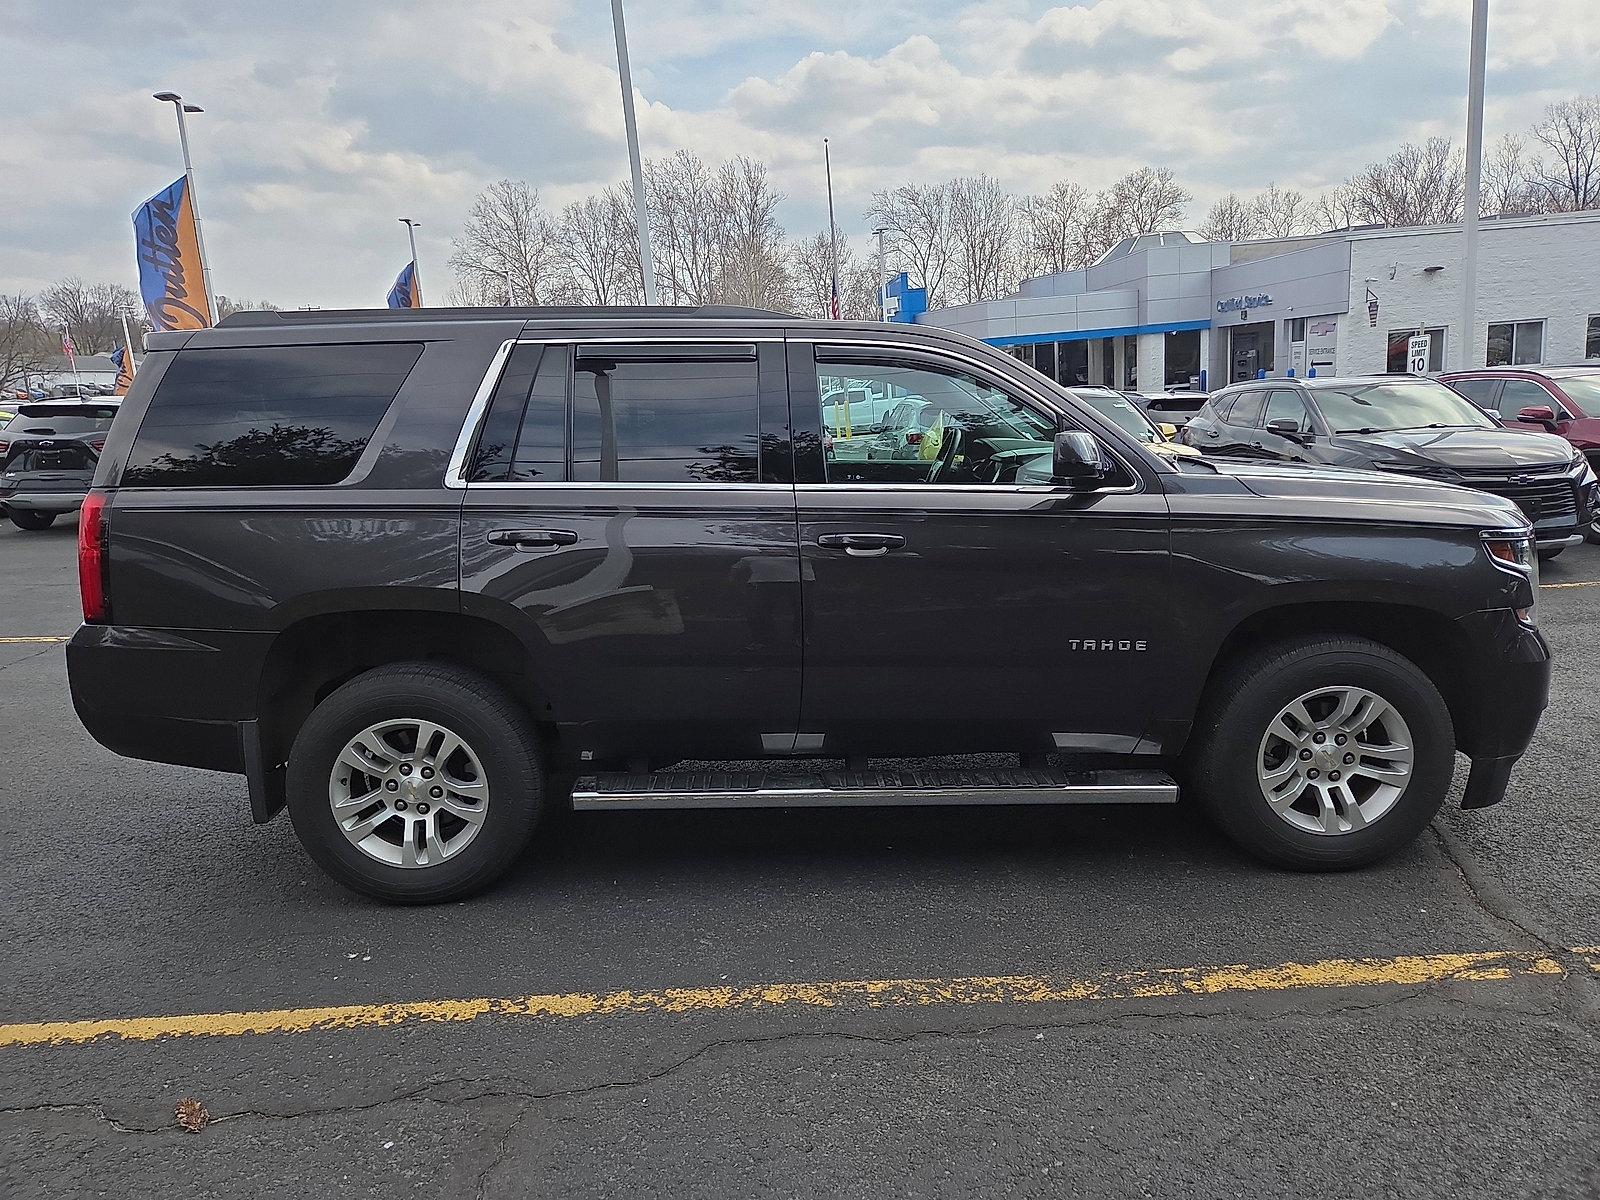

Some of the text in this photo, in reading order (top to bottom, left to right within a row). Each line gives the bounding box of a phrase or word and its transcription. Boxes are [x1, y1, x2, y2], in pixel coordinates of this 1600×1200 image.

[1411, 340, 1427, 349] SPEED
[1411, 349, 1426, 357] LIMIT
[1411, 358, 1425, 372] 10
[1068, 639, 1147, 651] TAHOE
